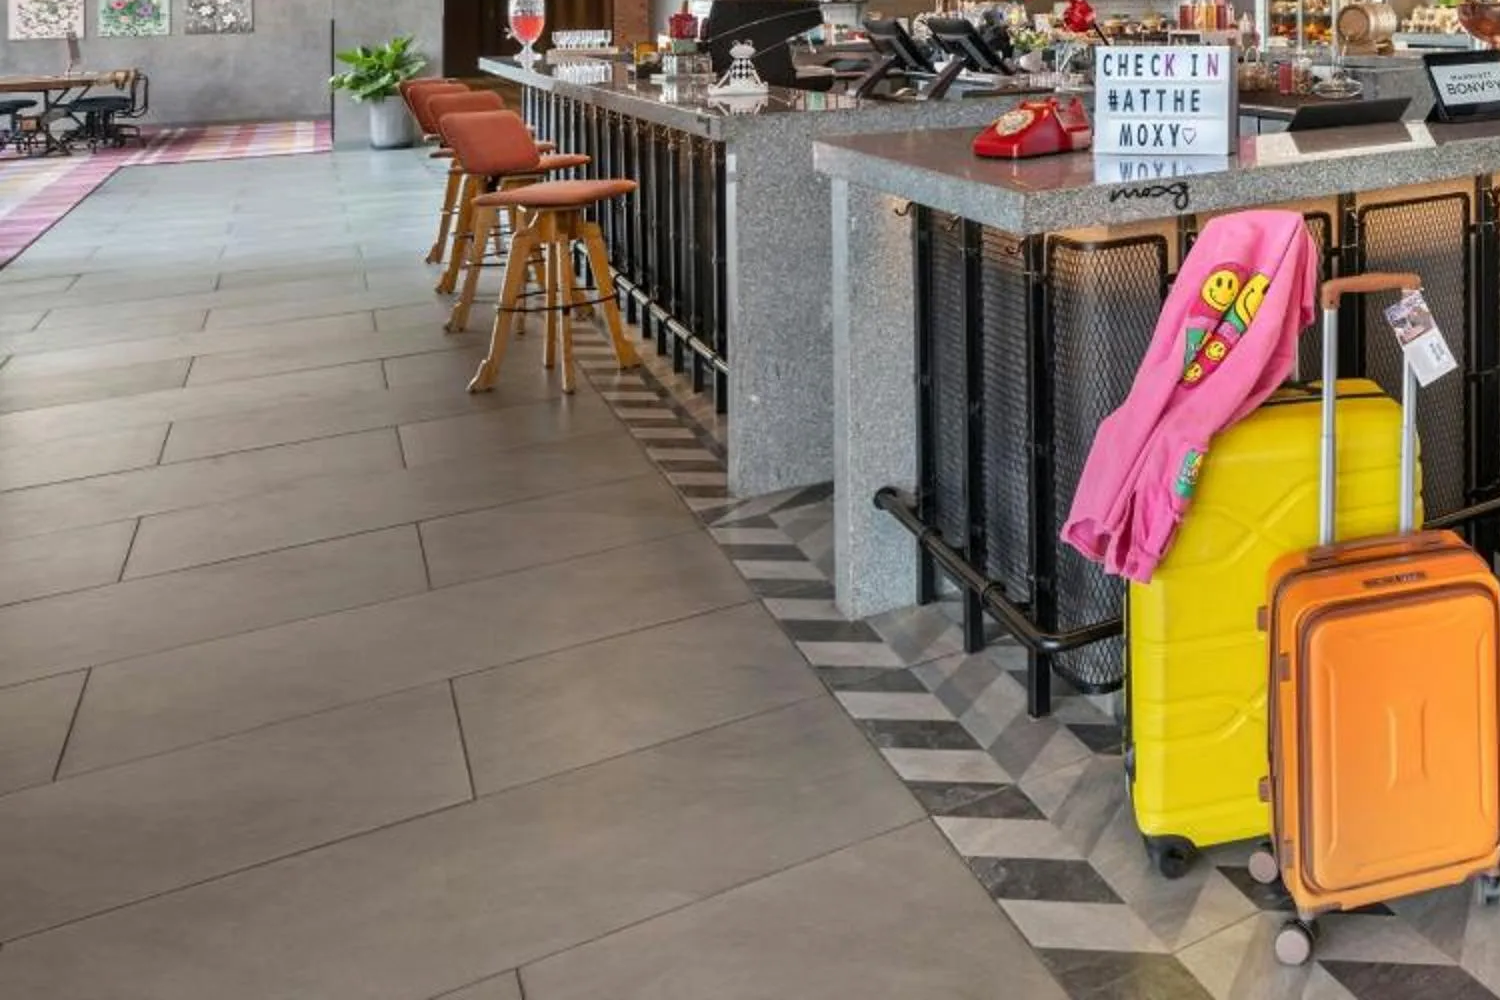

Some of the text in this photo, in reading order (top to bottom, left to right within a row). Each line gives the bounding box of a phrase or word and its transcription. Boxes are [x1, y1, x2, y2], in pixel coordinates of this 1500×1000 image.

[1103, 54, 1219, 77] CHECK IN
[1108, 89, 1201, 112] #ATTHE
[1120, 124, 1180, 147] MOXY
